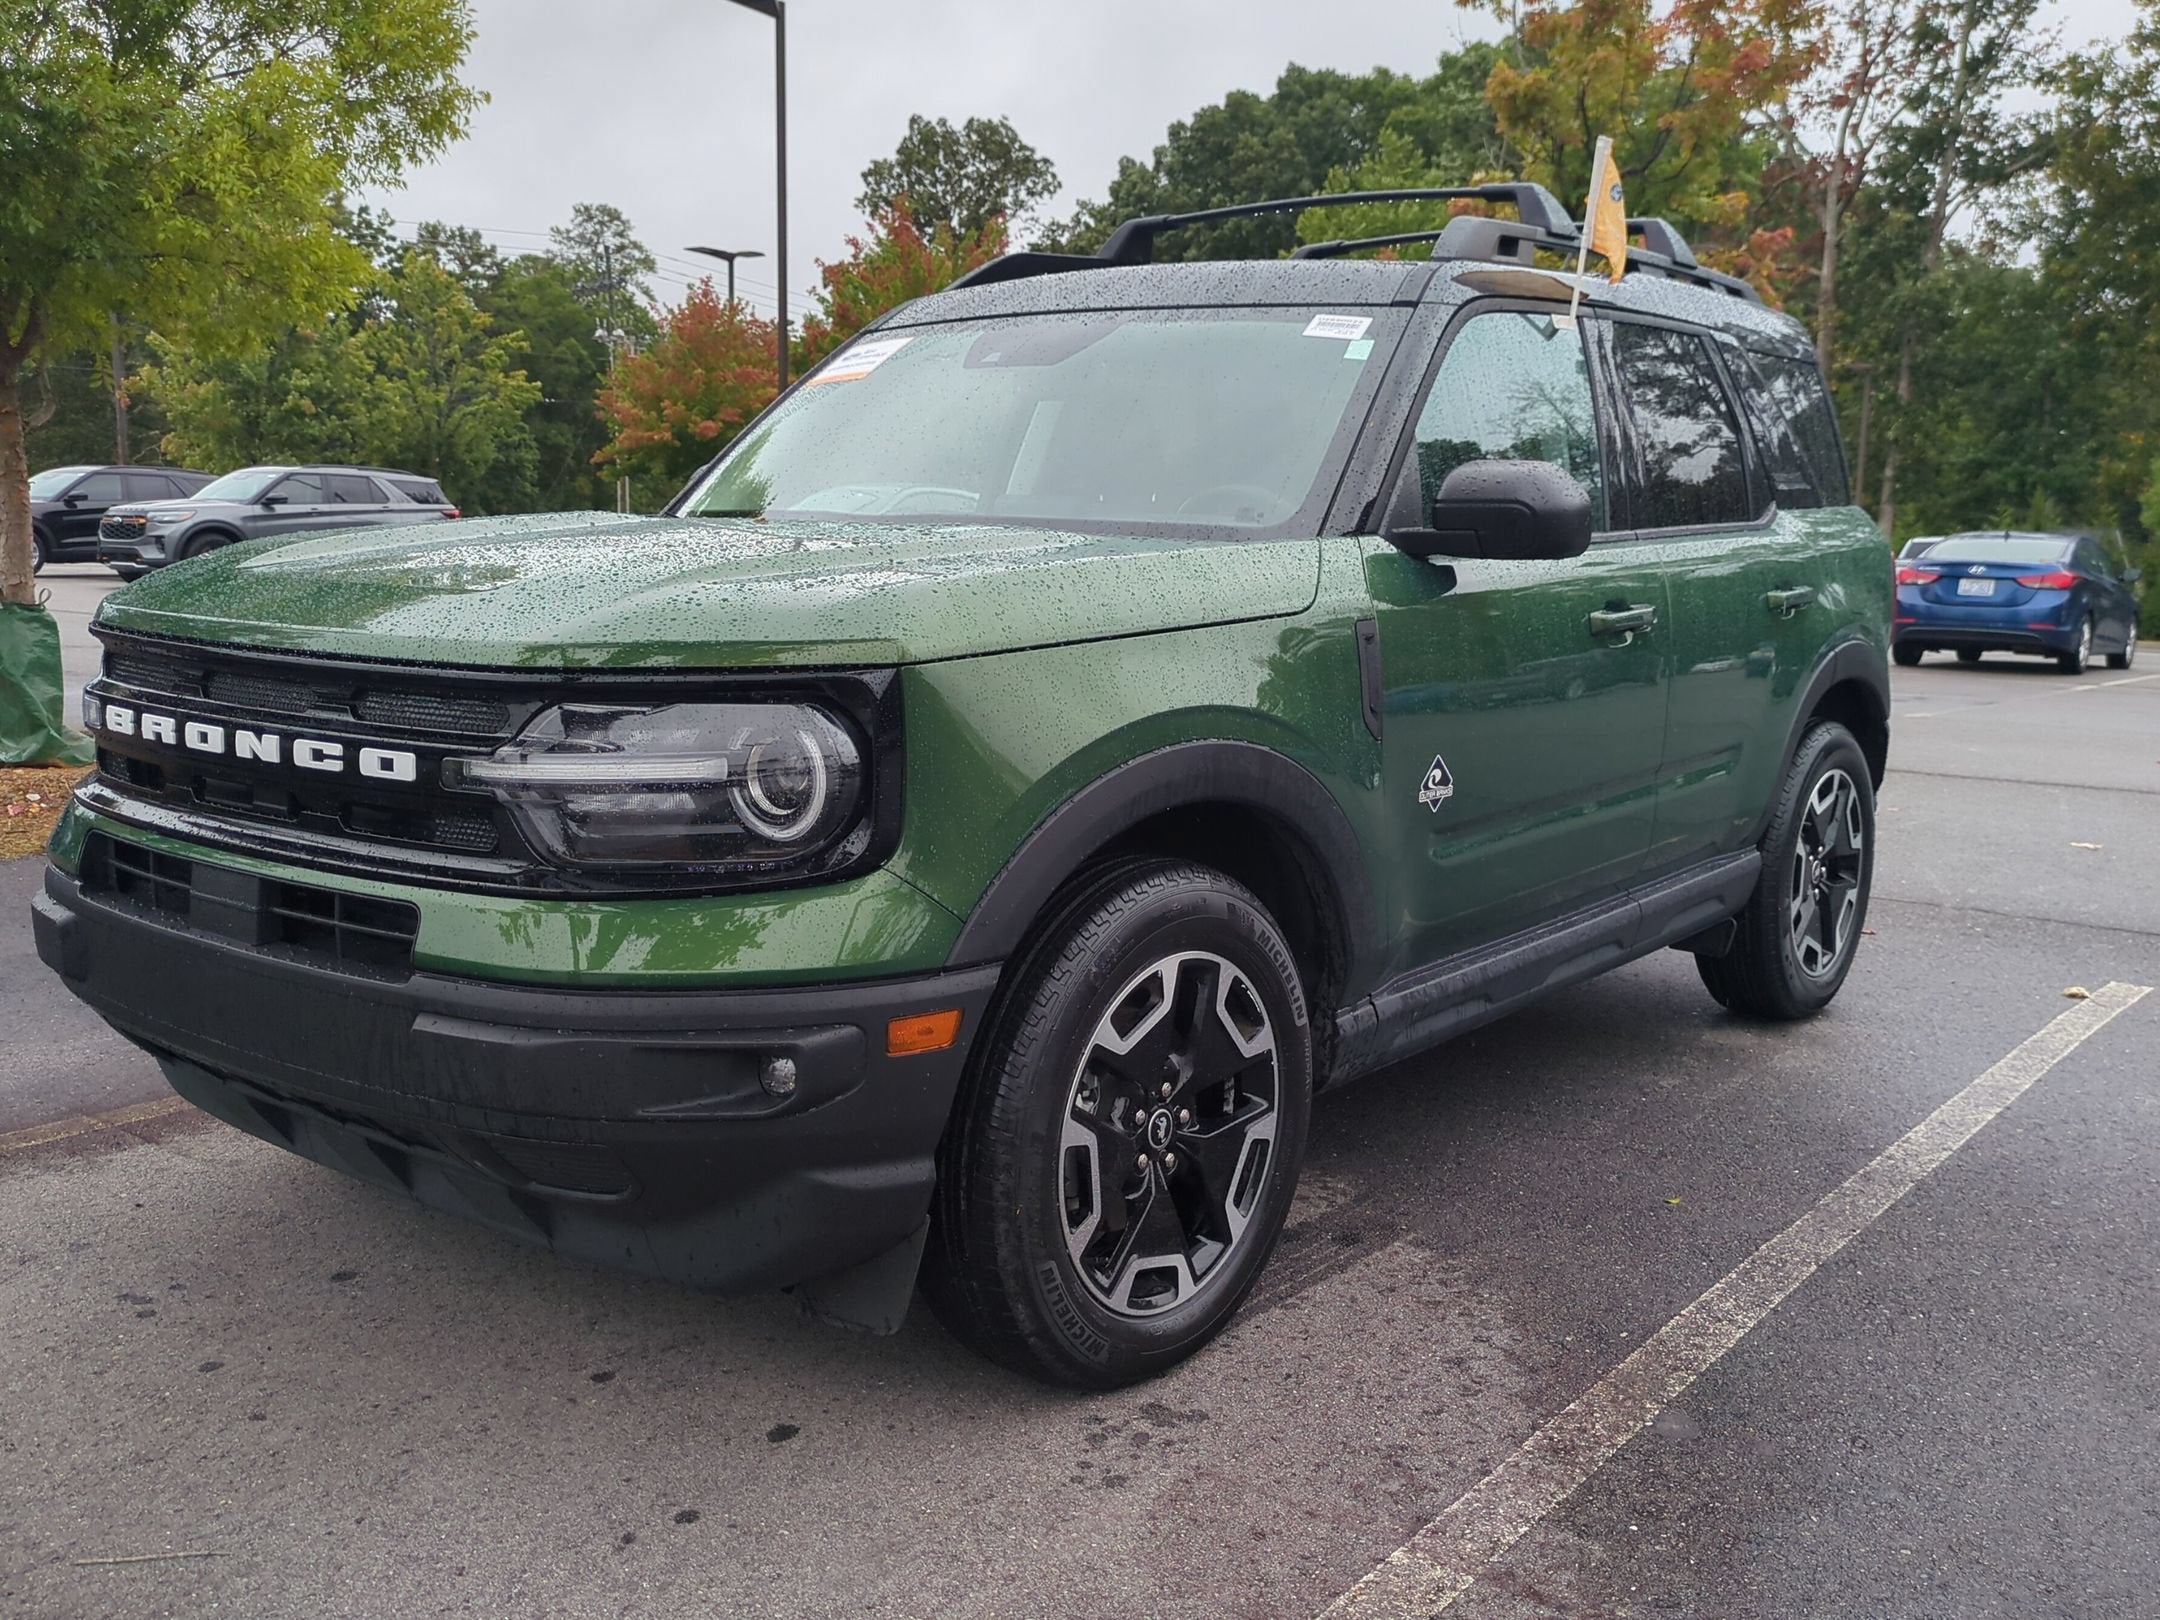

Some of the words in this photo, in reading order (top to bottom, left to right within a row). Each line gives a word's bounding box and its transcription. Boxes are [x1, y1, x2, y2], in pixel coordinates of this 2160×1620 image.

[106, 704, 416, 781] BRONCO
[1257, 929, 1305, 1021] MICHELIN
[1040, 1268, 1105, 1357] MICHELIN
